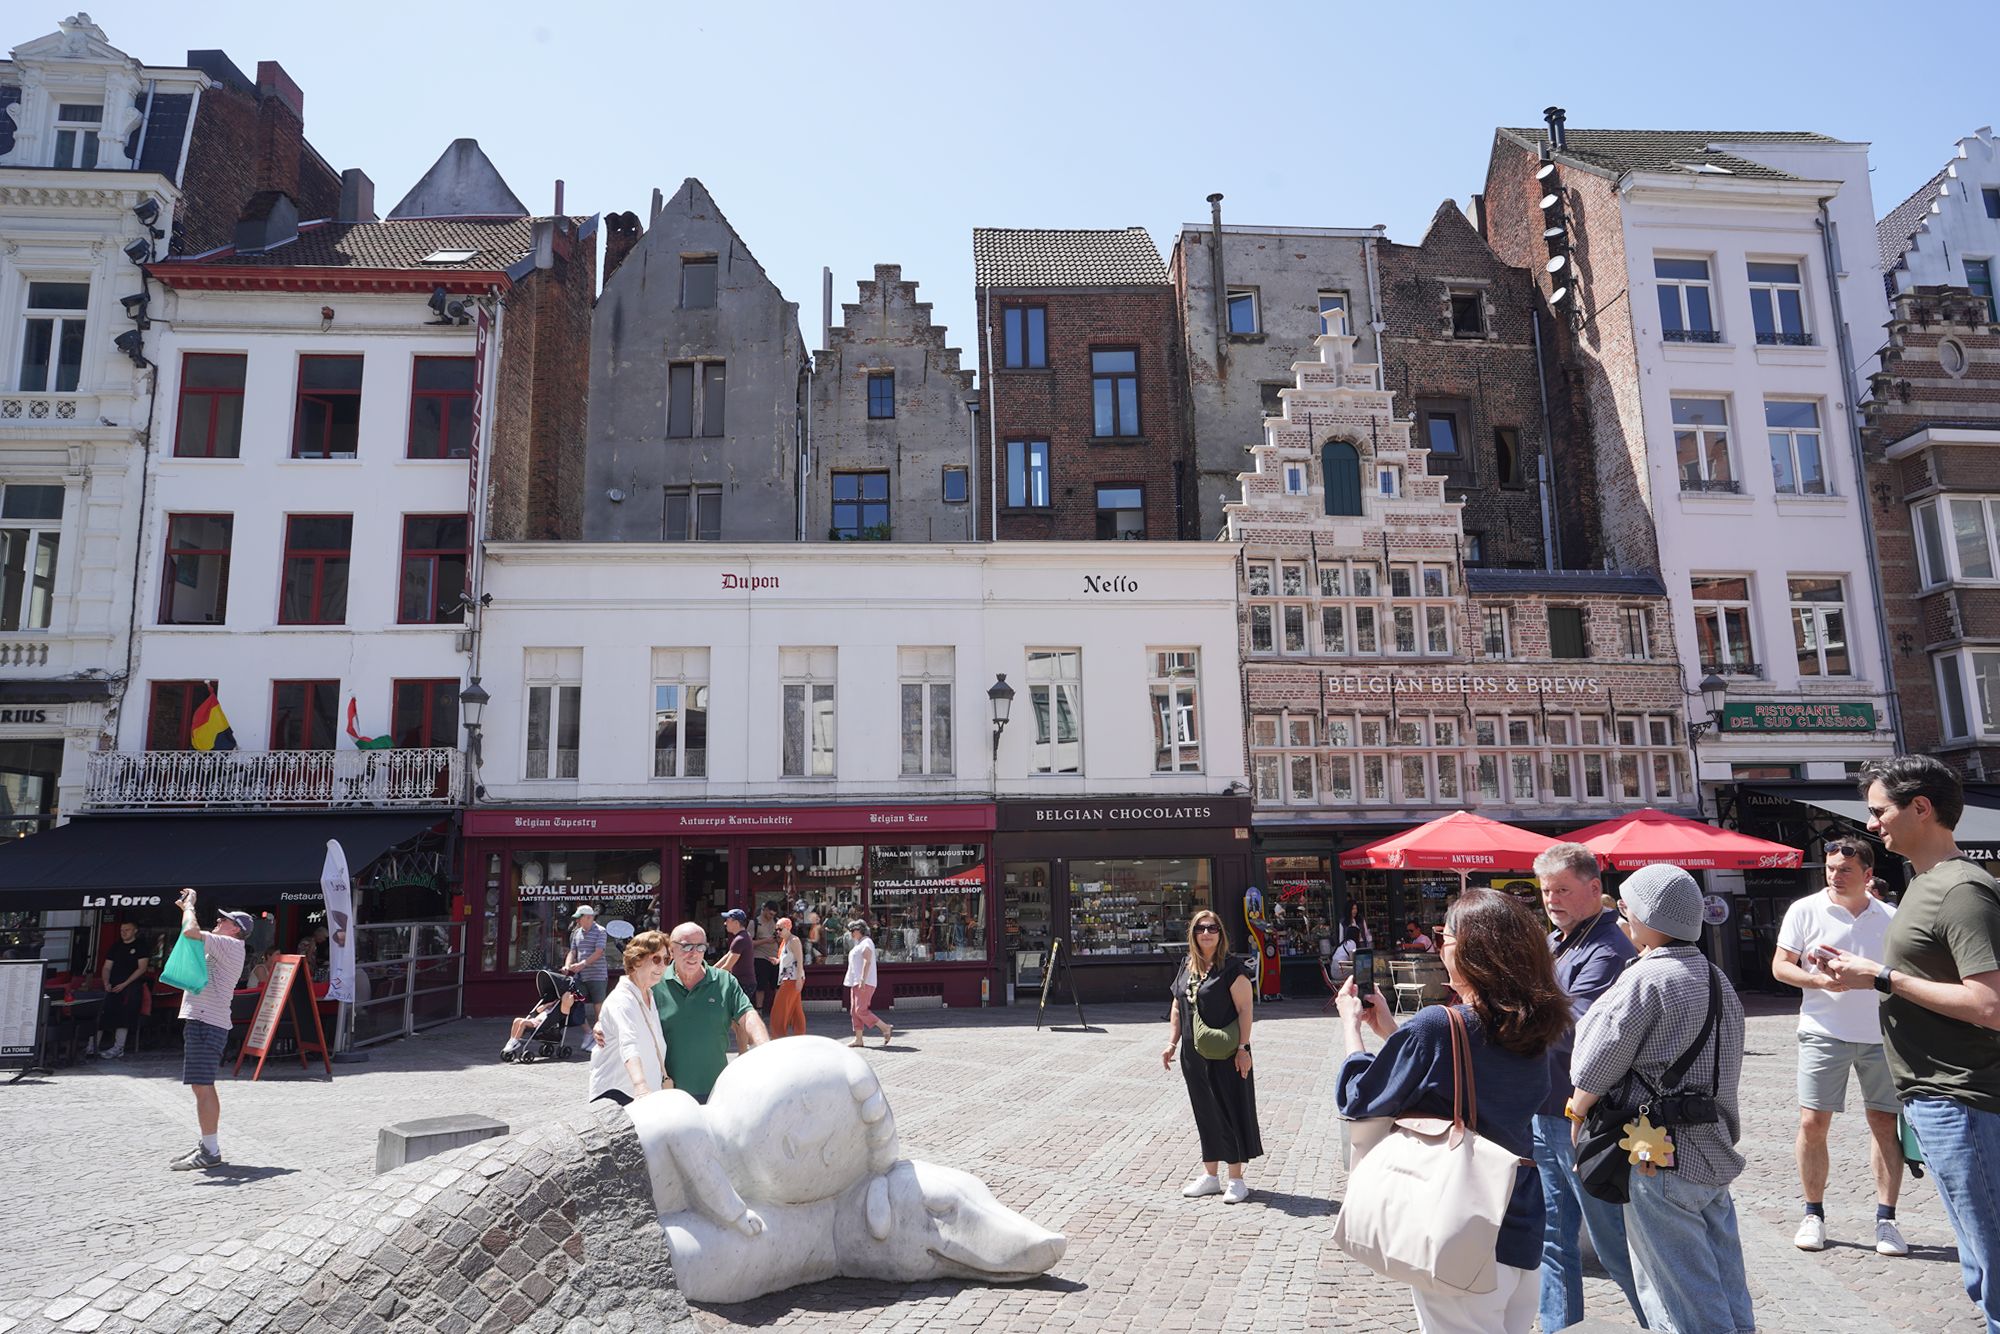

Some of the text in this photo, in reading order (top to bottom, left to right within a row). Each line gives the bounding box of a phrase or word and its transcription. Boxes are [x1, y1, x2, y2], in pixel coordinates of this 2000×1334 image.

[466, 326, 486, 582] PIZZERIA
[721, 573, 779, 590] Dupon
[1083, 575, 1138, 593] Nello
[1329, 677, 1599, 693] BELGIAN BEERS & BREWS
[1755, 705, 1840, 717] RISTORANTE
[1730, 716, 1867, 728] DEL SUD CLASSICO
[870, 813, 928, 824] Belgian Lace
[1036, 807, 1211, 821] BELGIAN CHOCOLATES
[515, 817, 597, 828] Belgian Tapestry
[679, 816, 726, 826] Antwerps
[1452, 854, 1494, 864] ANTWERPEN
[1963, 849, 1994, 859] IZZA
[873, 878, 982, 887] TOTAL CLEARANCE SALE
[518, 884, 653, 895] TOTALE UITVERKOOP
[873, 888, 917, 896] ANTWERP'S
[82, 894, 161, 907] La Torre
[280, 892, 324, 901] Restaura
